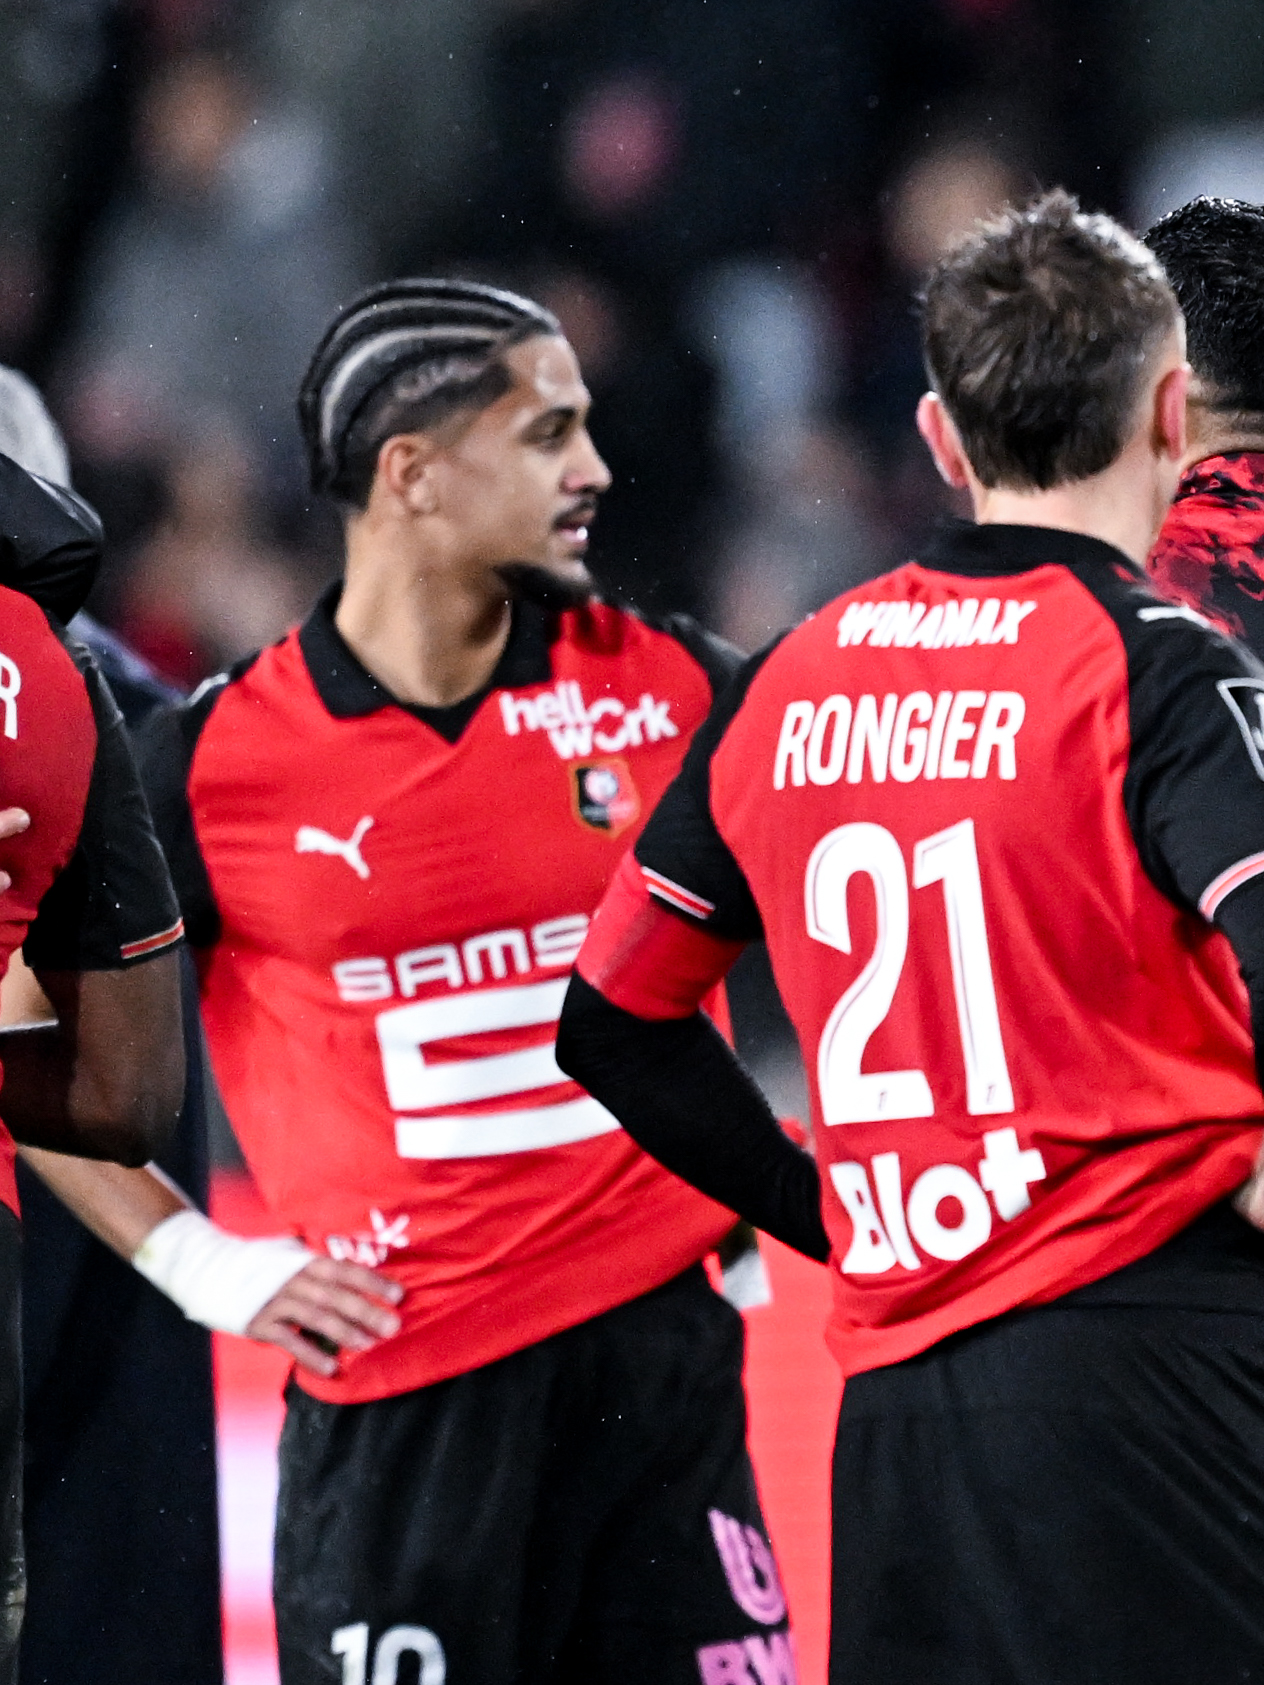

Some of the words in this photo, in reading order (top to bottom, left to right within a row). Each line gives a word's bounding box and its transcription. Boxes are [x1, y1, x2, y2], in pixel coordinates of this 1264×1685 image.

[837, 598, 1038, 649] WINAMAX
[773, 688, 1026, 790] RONGIER
[804, 817, 1015, 1126] 21
[829, 1127, 1047, 1275] Blot
